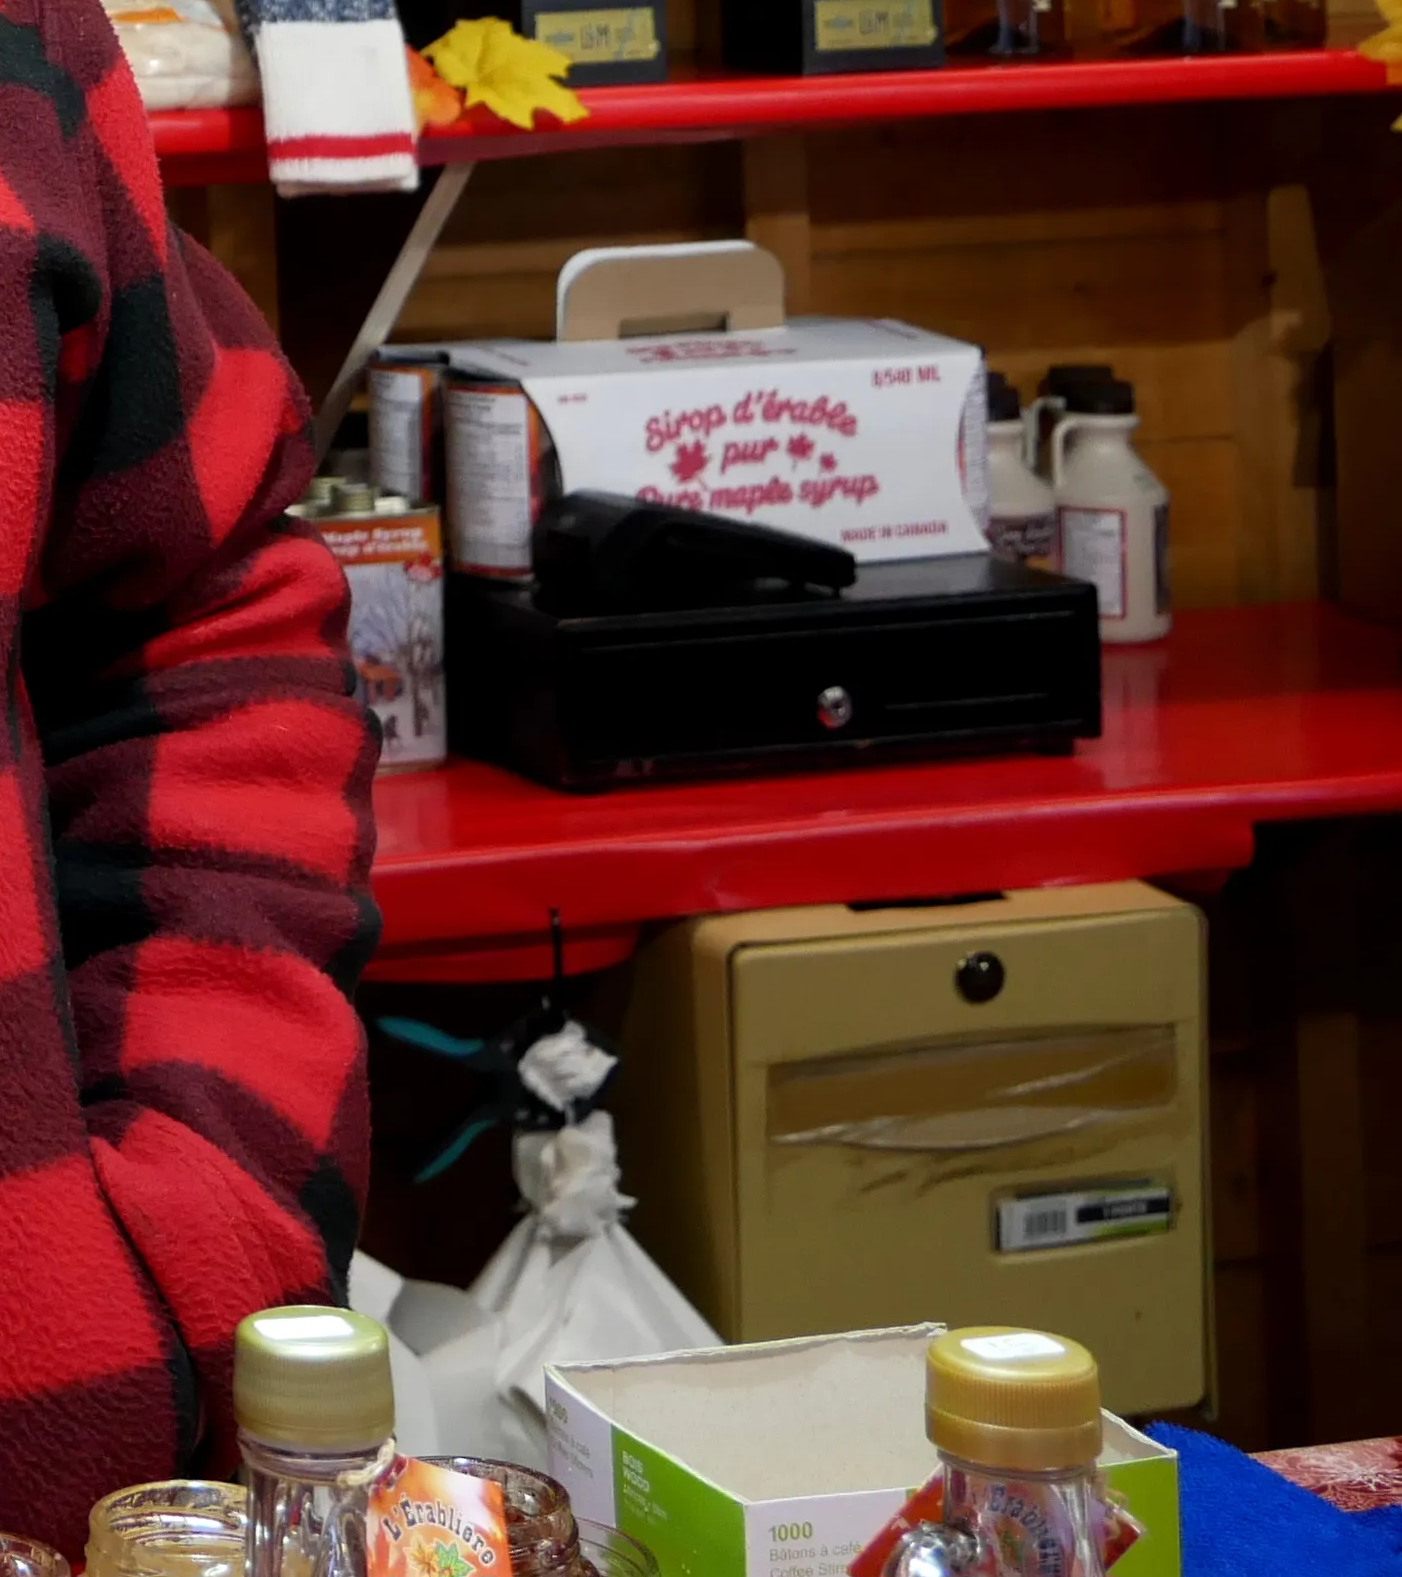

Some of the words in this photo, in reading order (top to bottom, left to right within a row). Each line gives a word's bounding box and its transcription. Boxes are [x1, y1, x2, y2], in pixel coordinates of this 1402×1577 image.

[645, 405, 727, 452] Sirop
[733, 389, 858, 437] d'érable
[721, 437, 779, 475] pur
[710, 476, 794, 514] maple
[799, 474, 880, 509] syrup
[768, 1521, 813, 1542] 1000
[769, 1548, 816, 1562] Bâtons
[820, 1543, 829, 1557] à
[833, 1540, 862, 1556] café
